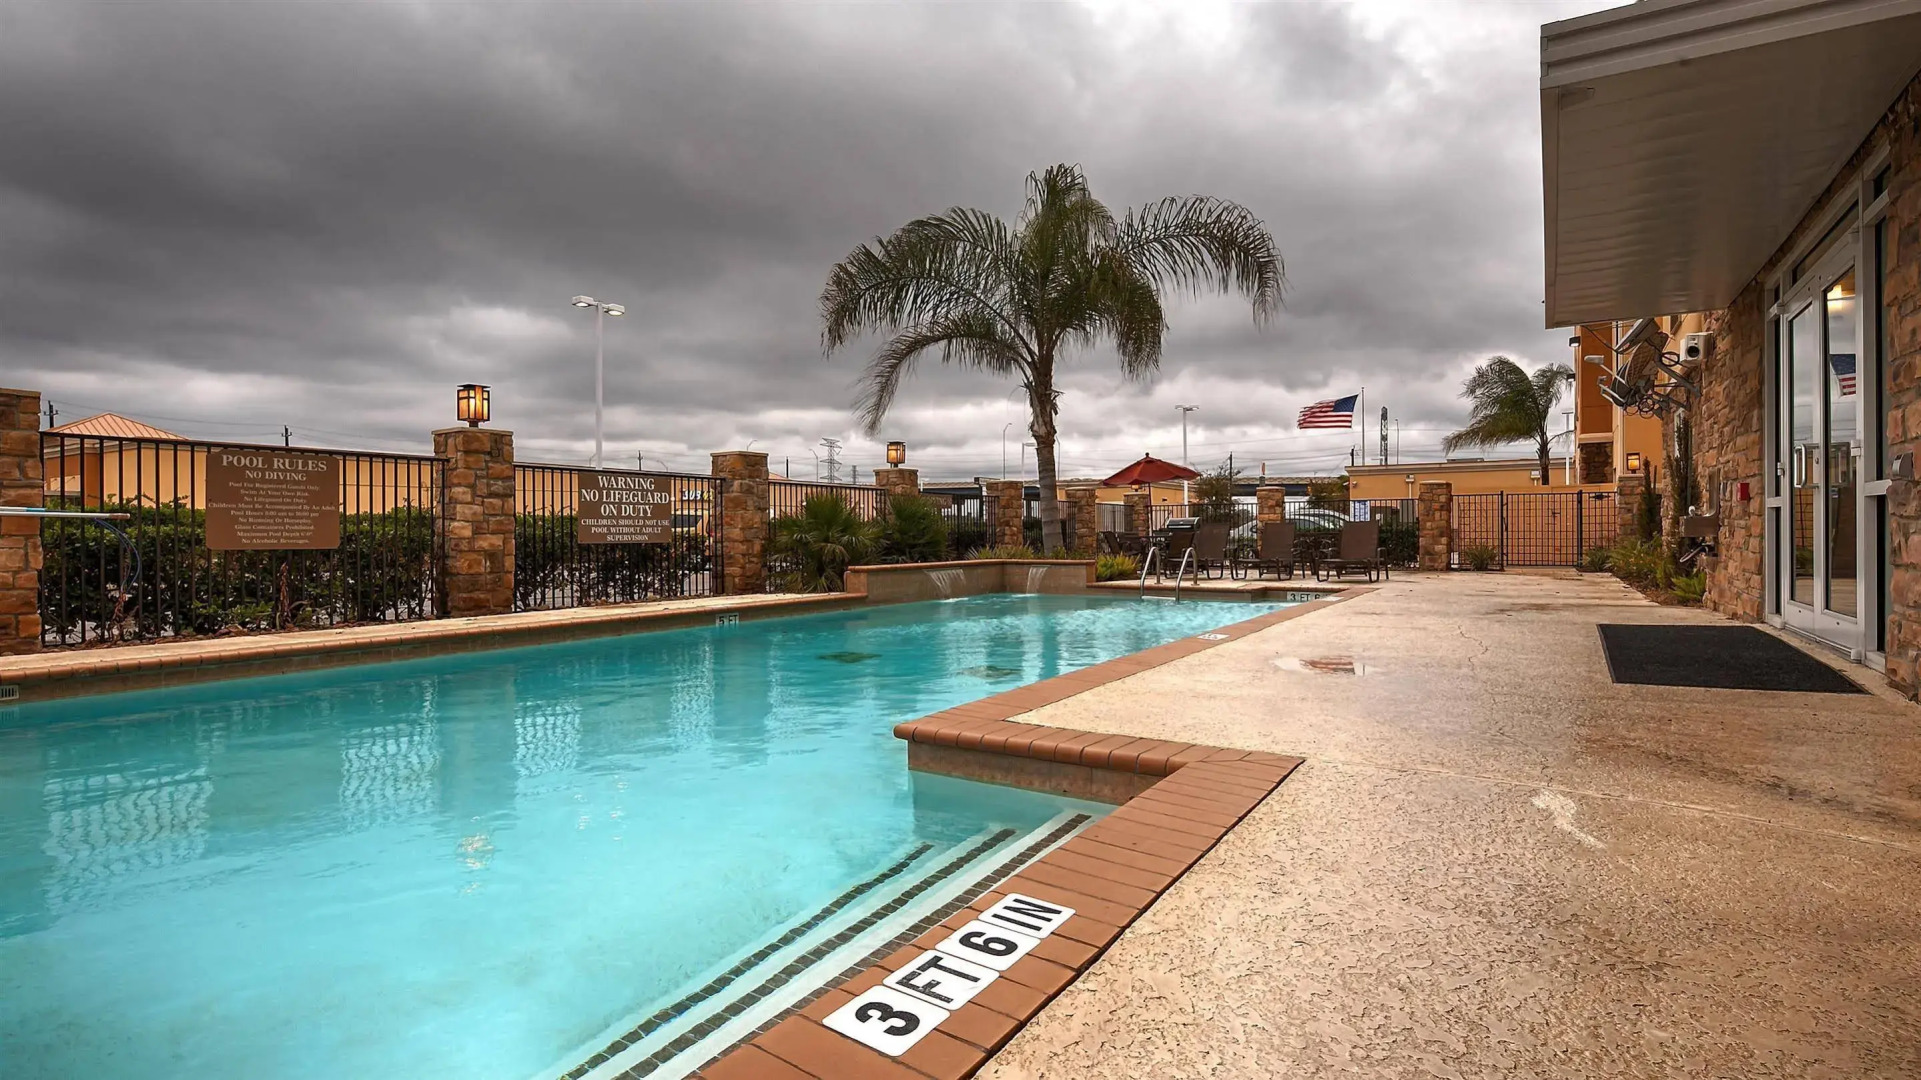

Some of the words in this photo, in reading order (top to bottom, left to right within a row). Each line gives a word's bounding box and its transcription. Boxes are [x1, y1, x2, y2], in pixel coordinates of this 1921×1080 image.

[222, 454, 268, 468] POOL
[273, 458, 327, 471] RULES
[245, 470, 262, 479] NO
[265, 471, 307, 481] DIVING
[598, 475, 655, 490] WARNING
[581, 489, 599, 501] NO
[602, 490, 670, 504] LIFEGUARD
[601, 504, 618, 516] ON
[621, 504, 653, 517] DUTY
[581, 518, 617, 526] CHILDREN
[1290, 593, 1296, 602] 3
[1300, 594, 1310, 602] FT
[728, 614, 738, 626] FT
[855, 1001, 920, 1036] 3
[895, 954, 981, 1004] FT
[959, 931, 1018, 956] 6
[991, 898, 1063, 932] IN
